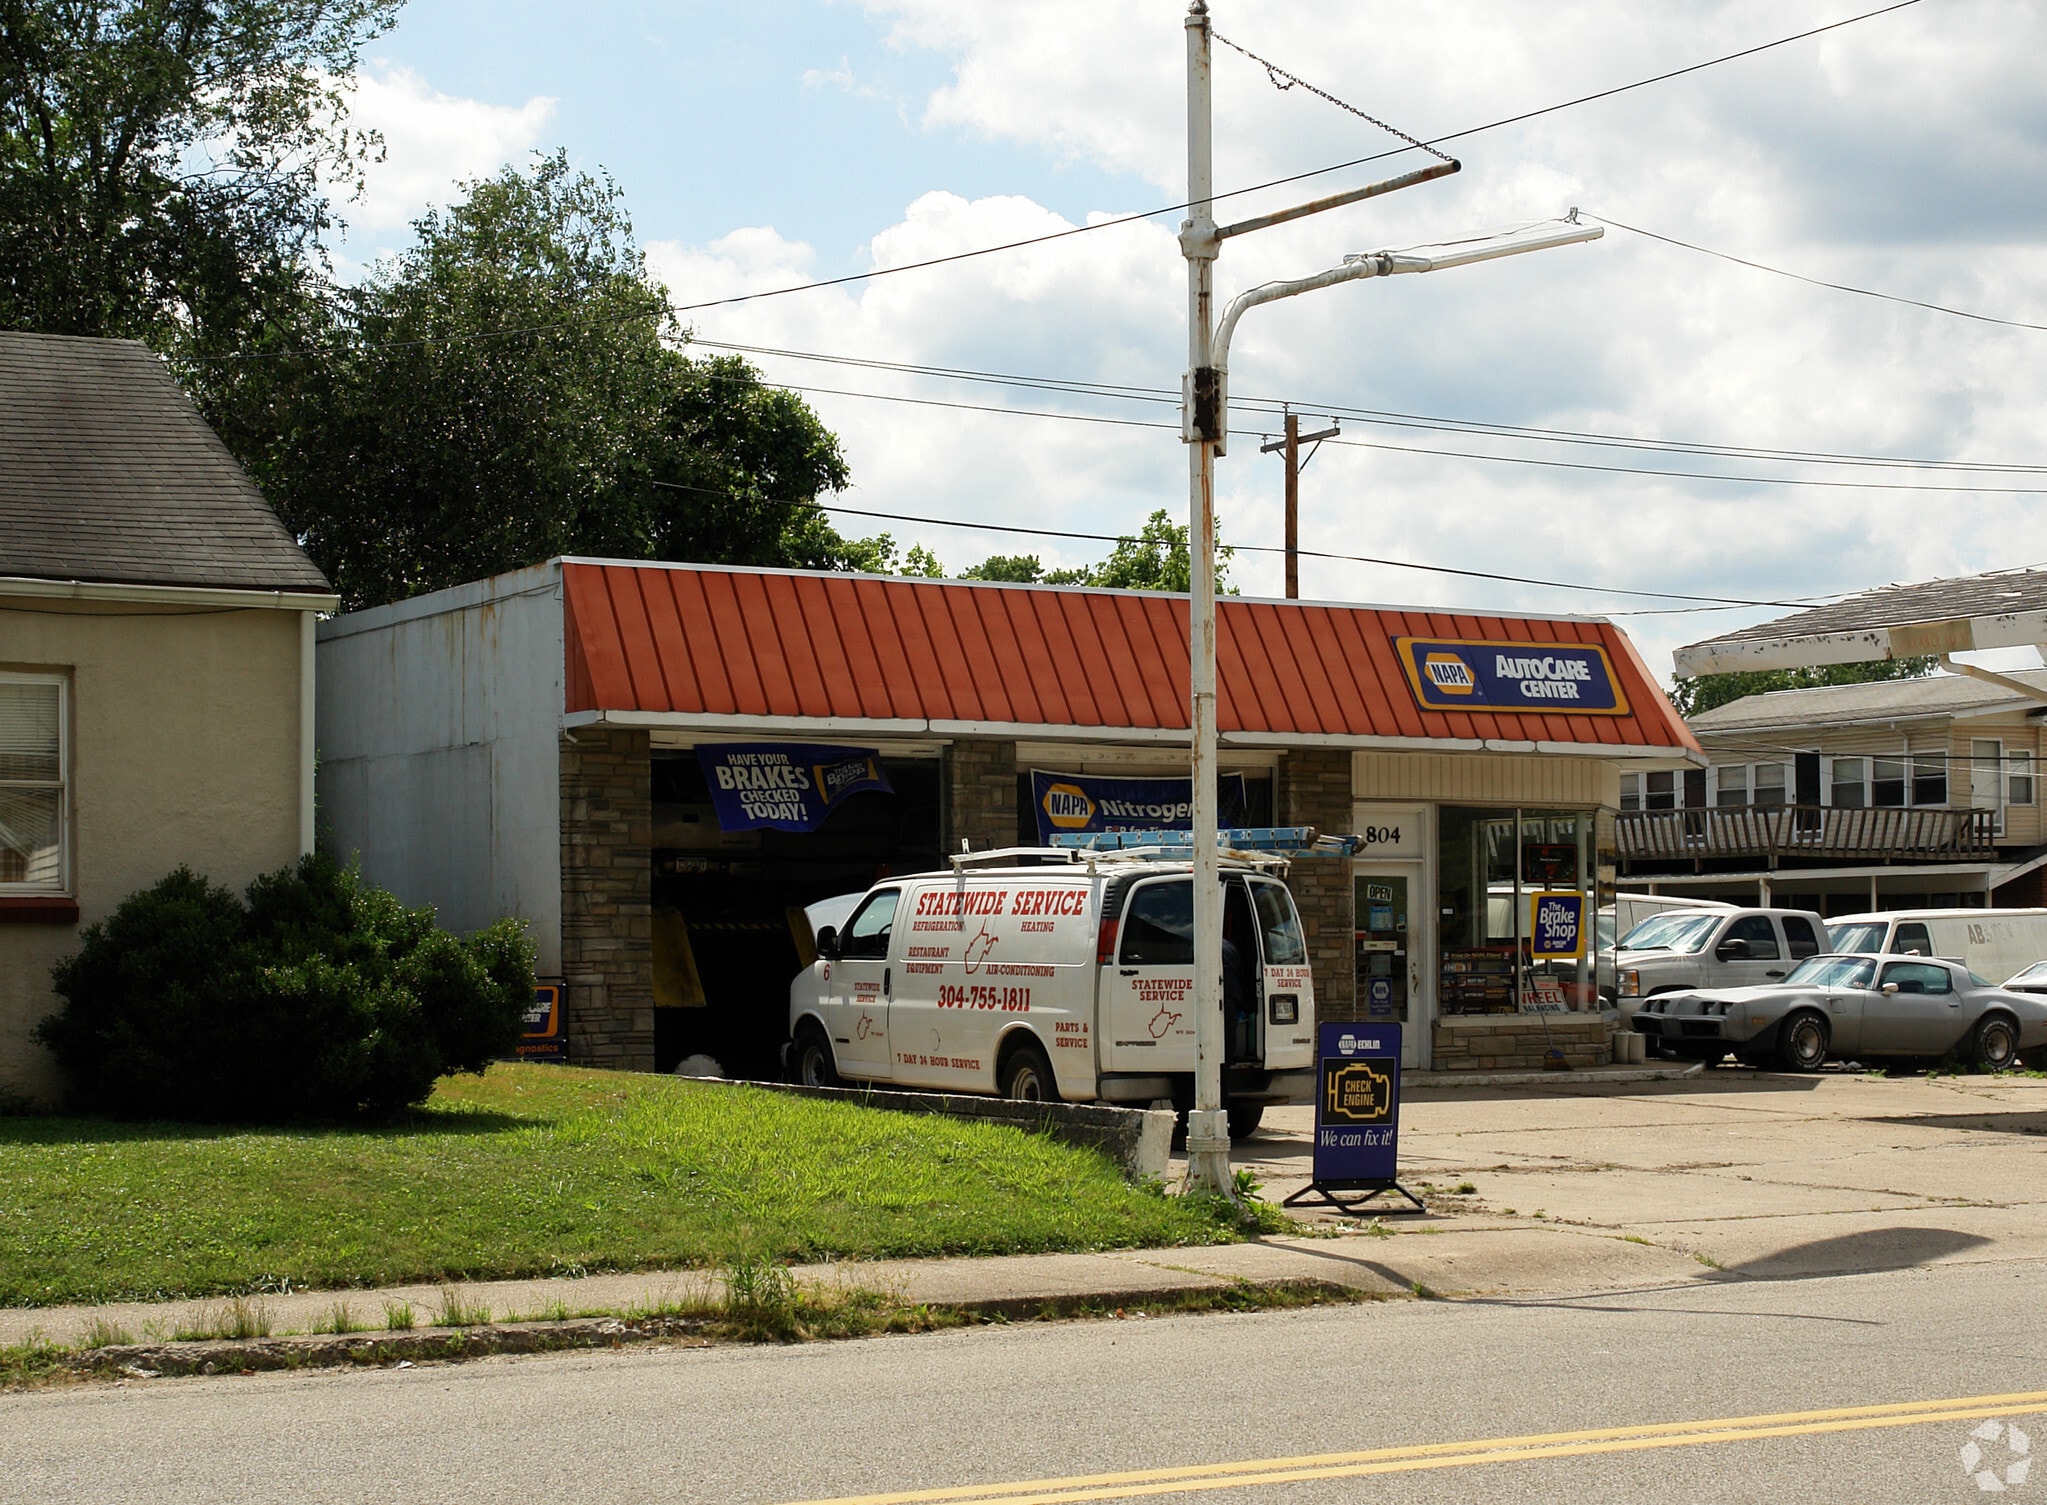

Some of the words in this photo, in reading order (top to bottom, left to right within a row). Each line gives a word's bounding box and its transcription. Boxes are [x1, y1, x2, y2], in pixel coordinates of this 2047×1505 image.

[1431, 664, 1471, 686] NAPA
[1520, 681, 1581, 699] CENTER
[728, 754, 758, 766] HAVE
[758, 754, 790, 766] YOUR
[715, 766, 810, 790] BRAKES
[740, 789, 800, 803] CHECKED
[1050, 792, 1091, 817] NAPA
[741, 802, 809, 822] TODAY!
[1366, 826, 1401, 845] 804
[1369, 886, 1392, 900] OPEN
[916, 891, 1008, 916] STATEWIDE
[1011, 891, 1088, 916] SERVICE
[1548, 902, 1562, 911] The
[1540, 907, 1576, 924] Brake
[912, 921, 965, 932] REFRIGERATION
[1021, 921, 1055, 933] HEATING
[1544, 922, 1577, 942] Shop
[908, 947, 950, 958] RESTAURANT
[823, 963, 831, 981] 6
[906, 963, 944, 974] EQUIPMENT
[986, 964, 1055, 977] AIR-CONDITIONING
[1271, 968, 1284, 978] DAY
[854, 982, 881, 992] STATEWIDE
[1132, 979, 1193, 990] STATEWIDE
[1277, 979, 1302, 988] SERVICE
[938, 984, 1031, 1012] 304-755-1811
[1140, 991, 1185, 1001] SERVICE
[1055, 1021, 1080, 1033] PARTS
[1082, 1022, 1089, 1033] &
[1055, 1037, 1089, 1049] SERVICE
[903, 1053, 917, 1065] DAY
[930, 1055, 949, 1067] HOUR
[952, 1058, 980, 1070] SERVICE
[1345, 1080, 1372, 1093] CHECK
[1343, 1093, 1375, 1107] ENGINE
[1320, 1130, 1337, 1147] We
[1340, 1132, 1361, 1147] can
[1364, 1130, 1378, 1147] fix
[1381, 1129, 1393, 1146] it!
